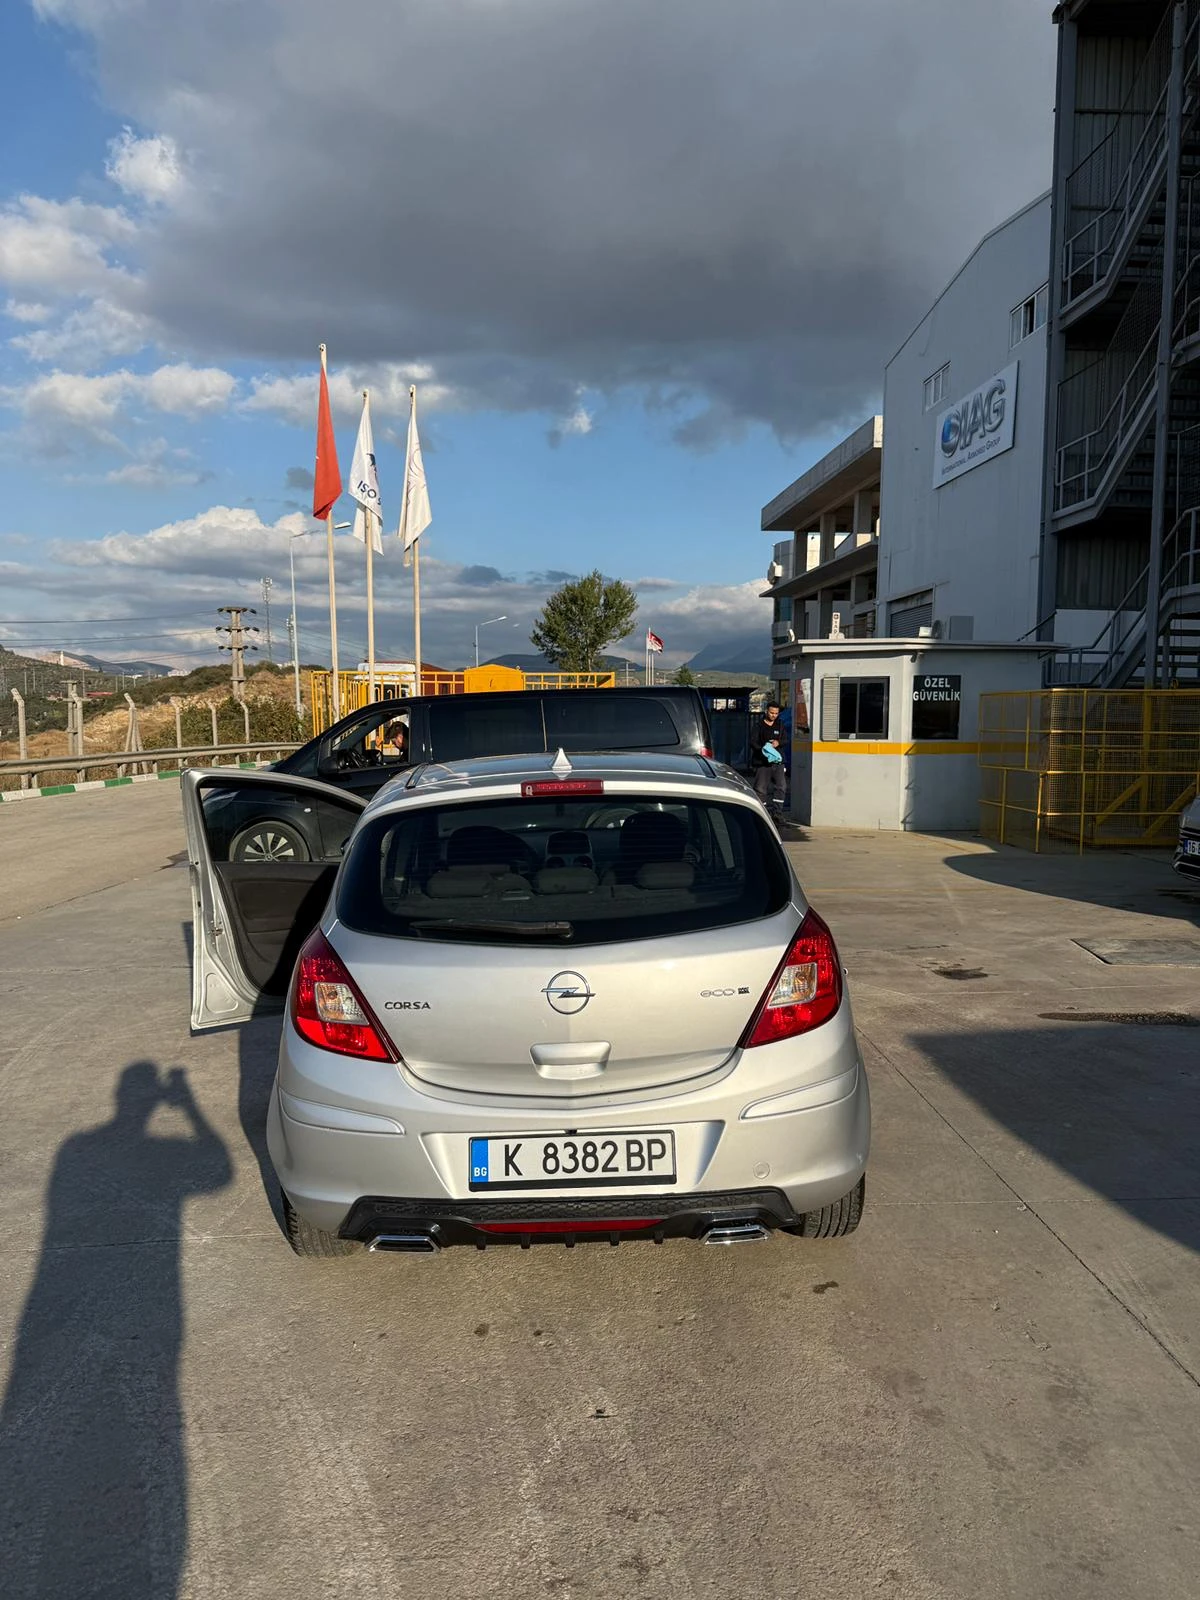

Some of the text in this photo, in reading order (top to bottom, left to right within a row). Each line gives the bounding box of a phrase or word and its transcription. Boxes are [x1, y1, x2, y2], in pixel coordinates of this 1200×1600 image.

[357, 480, 377, 499] ISO
[924, 676, 951, 688] ÖZEL
[913, 689, 961, 701] GÜVENLİK
[384, 1001, 431, 1010] CORSA
[504, 1143, 523, 1177] K
[474, 1166, 487, 1177] BG
